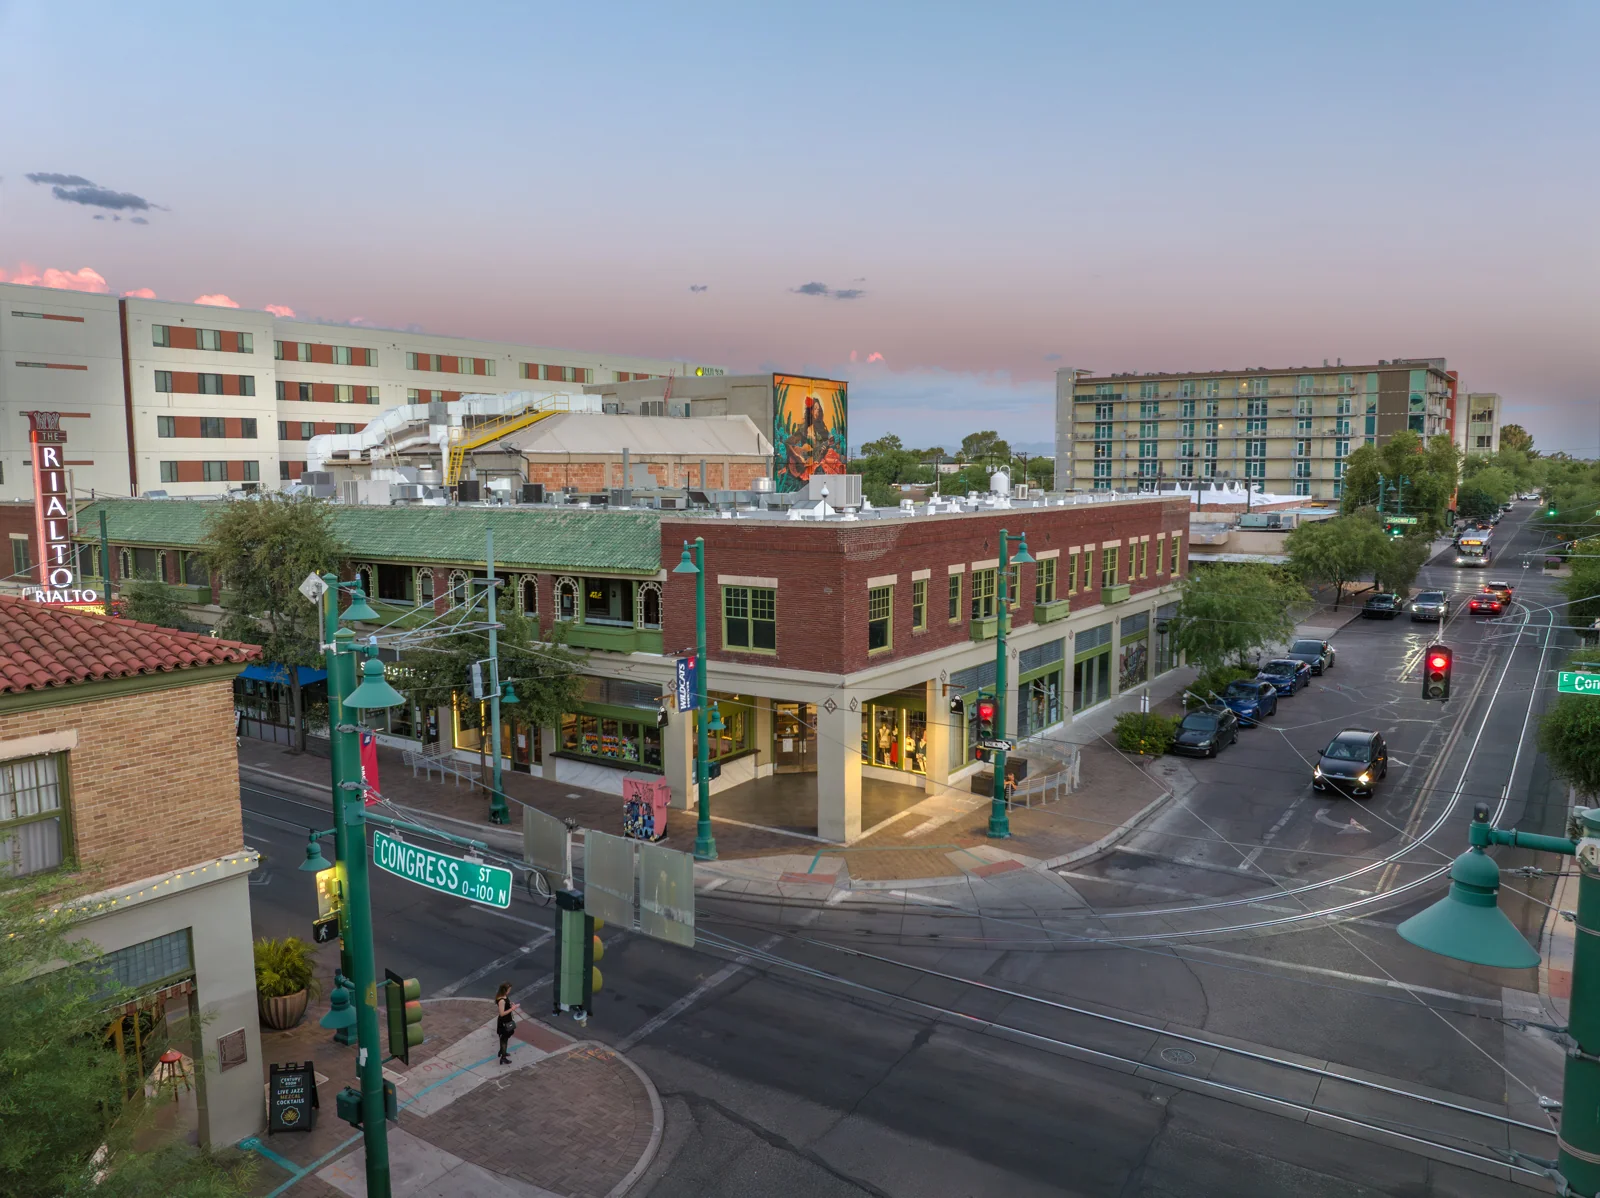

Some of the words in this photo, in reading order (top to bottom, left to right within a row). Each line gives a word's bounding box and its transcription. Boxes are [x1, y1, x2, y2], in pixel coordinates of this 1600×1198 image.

[42, 432, 59, 441] THE
[43, 447, 73, 588] RIALTO
[35, 589, 97, 603] RIALTO
[679, 663, 687, 710] WILDCATS
[1563, 673, 1569, 682] E
[1574, 675, 1600, 691] Con
[376, 834, 380, 847] E
[381, 839, 459, 890] CONGRESS
[478, 867, 491, 883] ST
[462, 880, 494, 902] 0-100
[498, 889, 507, 904] N
[276, 1098, 305, 1106] COCKTAILS
